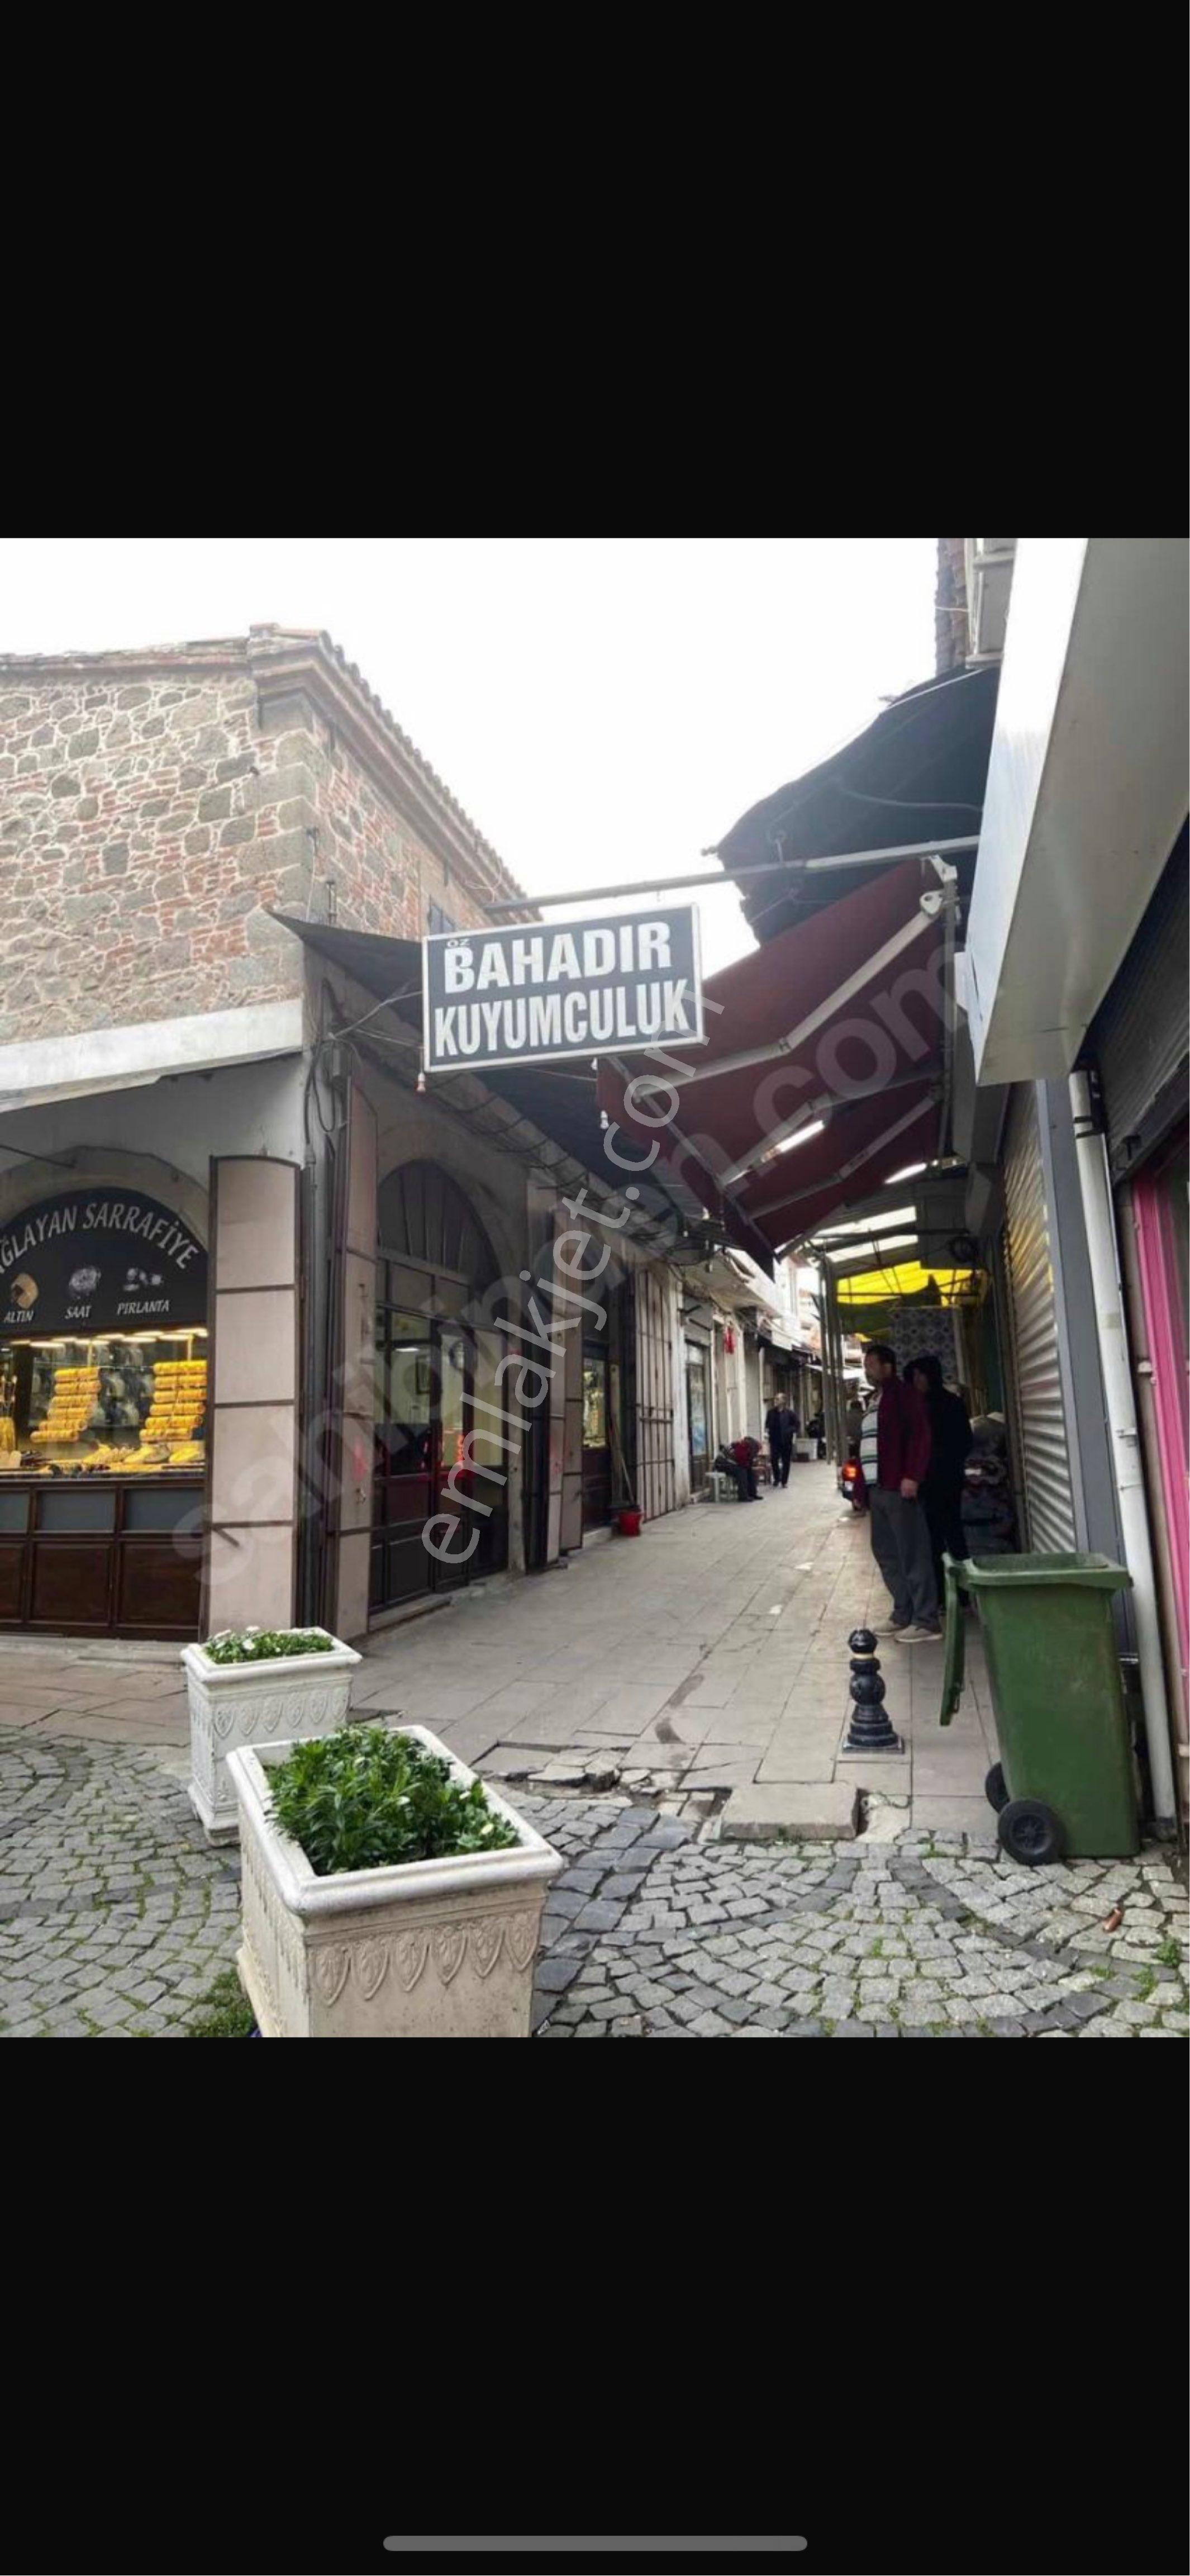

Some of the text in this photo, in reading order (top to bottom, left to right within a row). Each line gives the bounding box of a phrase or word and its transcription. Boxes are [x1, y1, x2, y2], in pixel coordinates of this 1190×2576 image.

[444, 922, 672, 993] BAHADIR
[435, 979, 690, 1057] KUYUMCULUK
[0, 1202, 199, 1274] ĞLAYAN SARRAFİYE
[3, 1310, 34, 1323] ALTIN
[64, 1305, 92, 1320] SAAT
